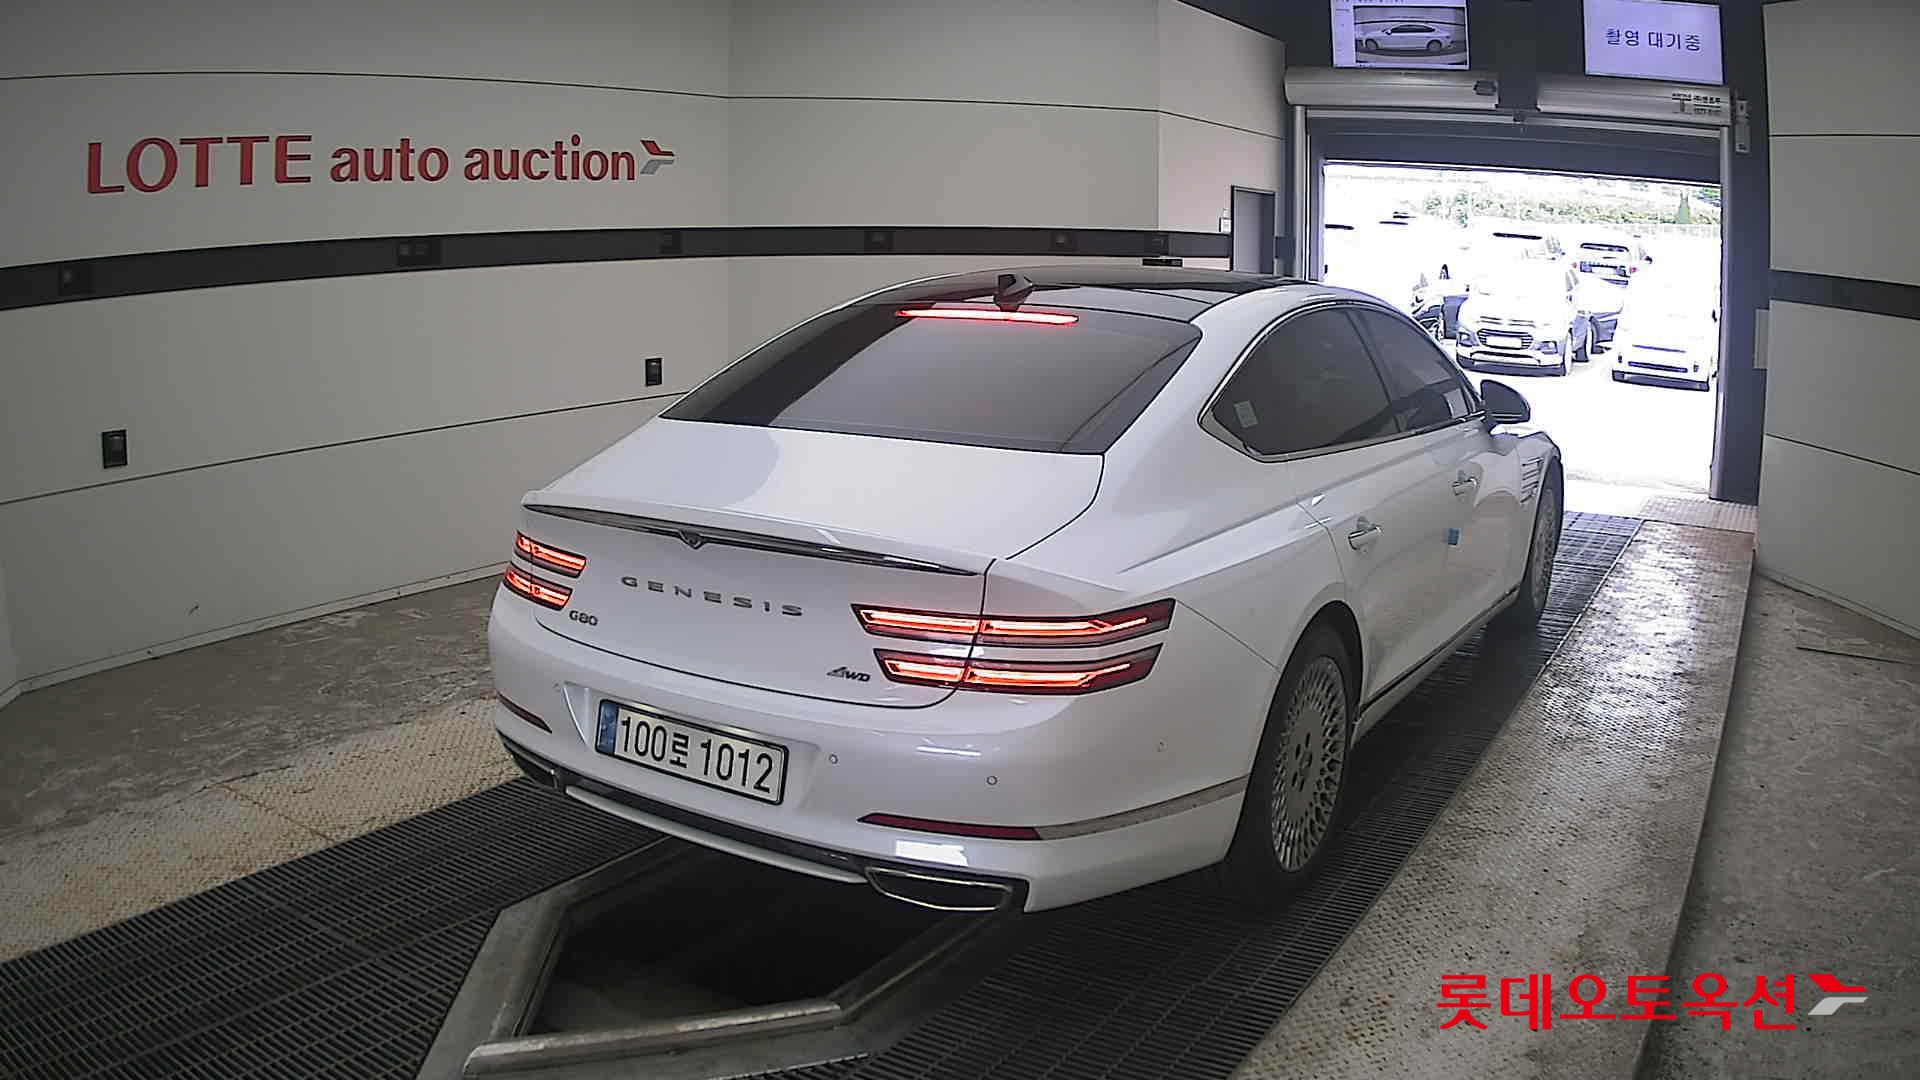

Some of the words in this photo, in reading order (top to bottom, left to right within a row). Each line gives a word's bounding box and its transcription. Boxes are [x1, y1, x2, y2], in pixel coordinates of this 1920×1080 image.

[1647, 31, 1701, 52] 대기중
[87, 134, 313, 194] LOTTE
[329, 138, 450, 182] auto
[463, 134, 636, 182] auction
[620, 575, 803, 618] GENESIS
[568, 609, 599, 627] G80
[826, 665, 871, 683] 4WD
[700, 738, 774, 794] 1012
